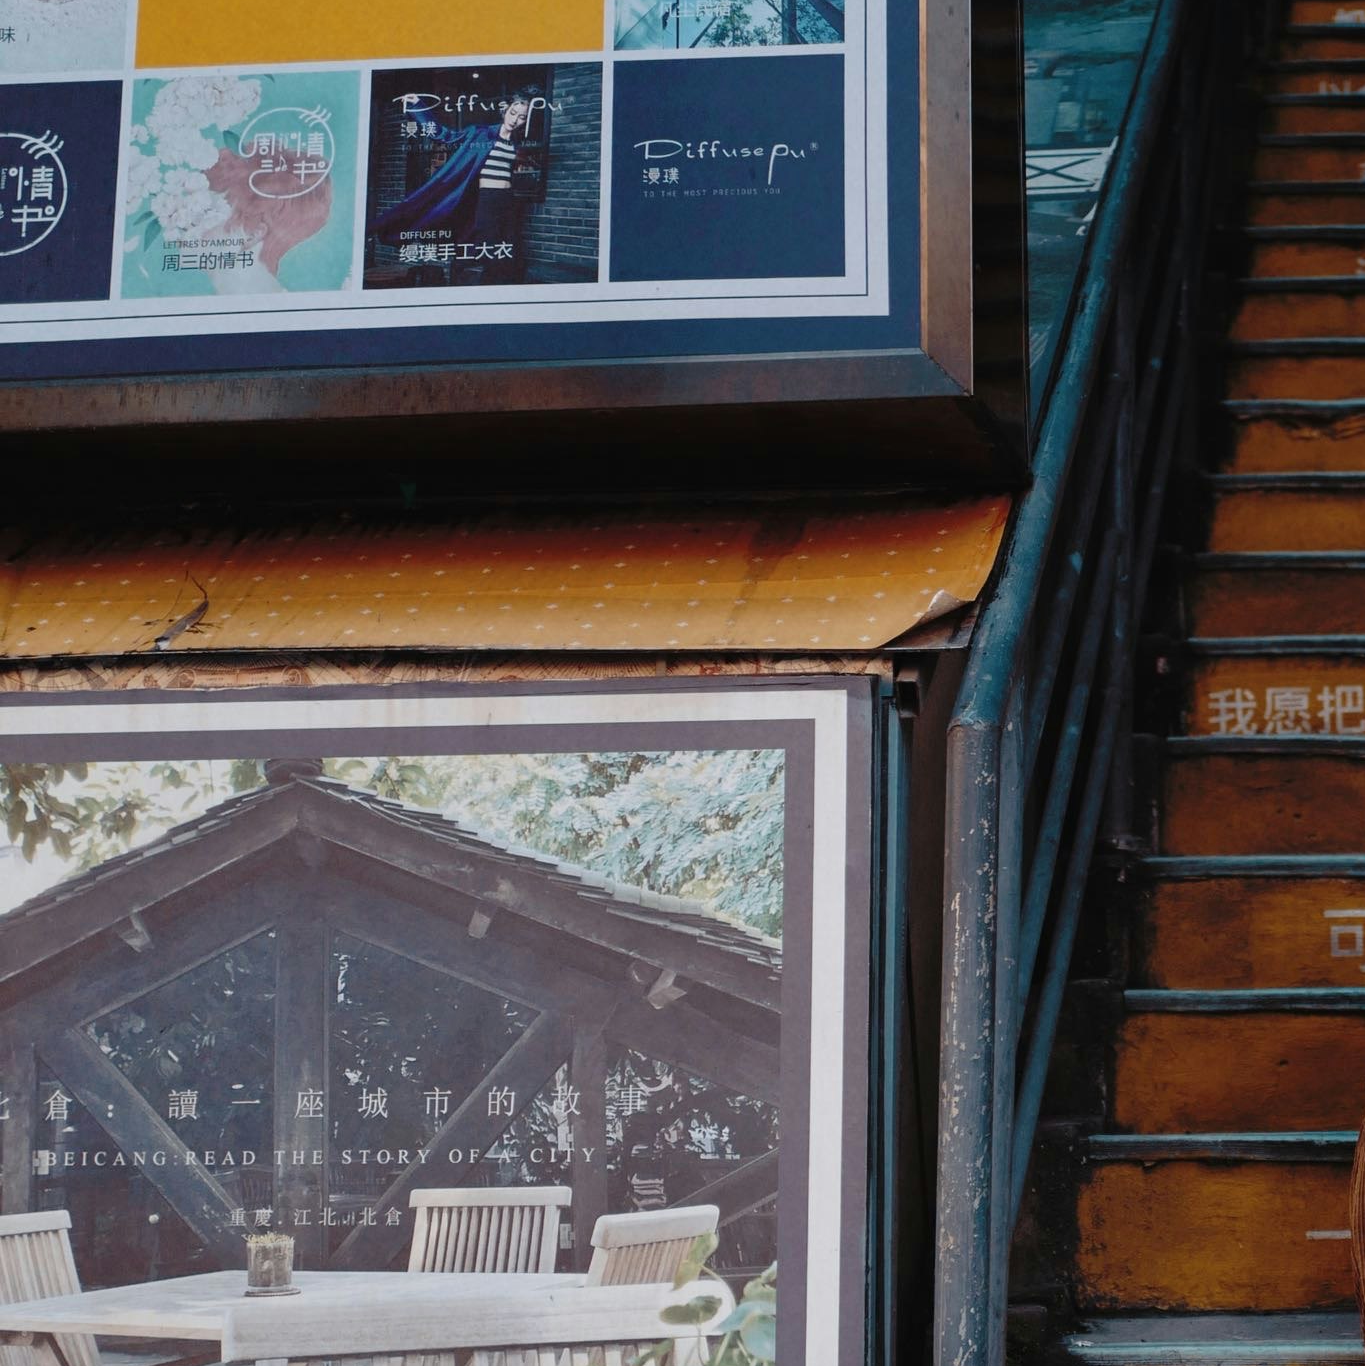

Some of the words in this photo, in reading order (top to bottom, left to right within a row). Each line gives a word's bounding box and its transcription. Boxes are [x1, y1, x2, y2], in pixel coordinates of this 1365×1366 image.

[400, 231, 437, 240] DIFFUSE
[438, 230, 452, 239] PU
[161, 250, 254, 272] 周三的情书
[273, 1150, 324, 1165] THE
[341, 1148, 433, 1165] STORY
[448, 1148, 481, 1165] OF
[497, 1147, 512, 1163] A
[529, 1147, 596, 1163] CITY
